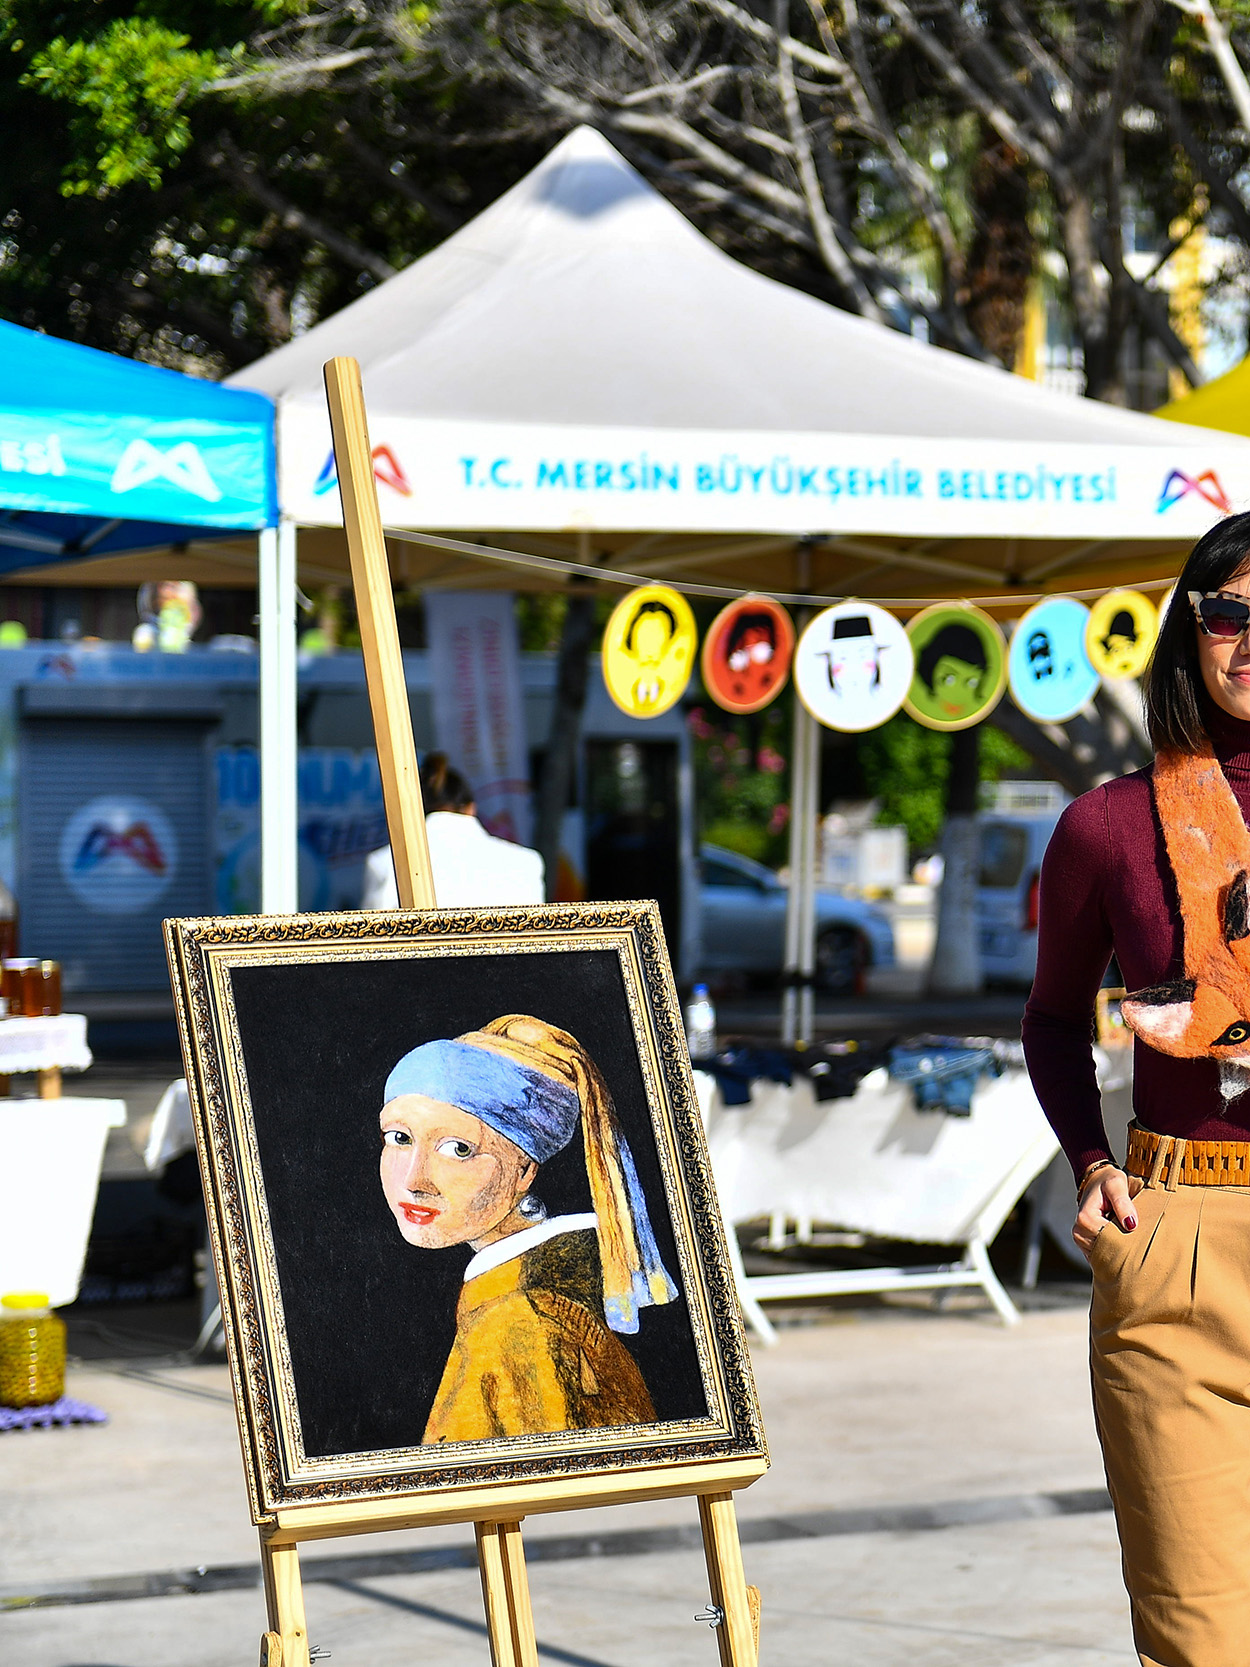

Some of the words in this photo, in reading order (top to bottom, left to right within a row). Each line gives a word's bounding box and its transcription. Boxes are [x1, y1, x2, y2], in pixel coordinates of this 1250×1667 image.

[458, 455, 523, 490] T.C.
[534, 452, 680, 492] MERSİN
[694, 454, 923, 504] BÜYÜKŞEHİR
[937, 464, 1118, 503] BELEDİYESİ
